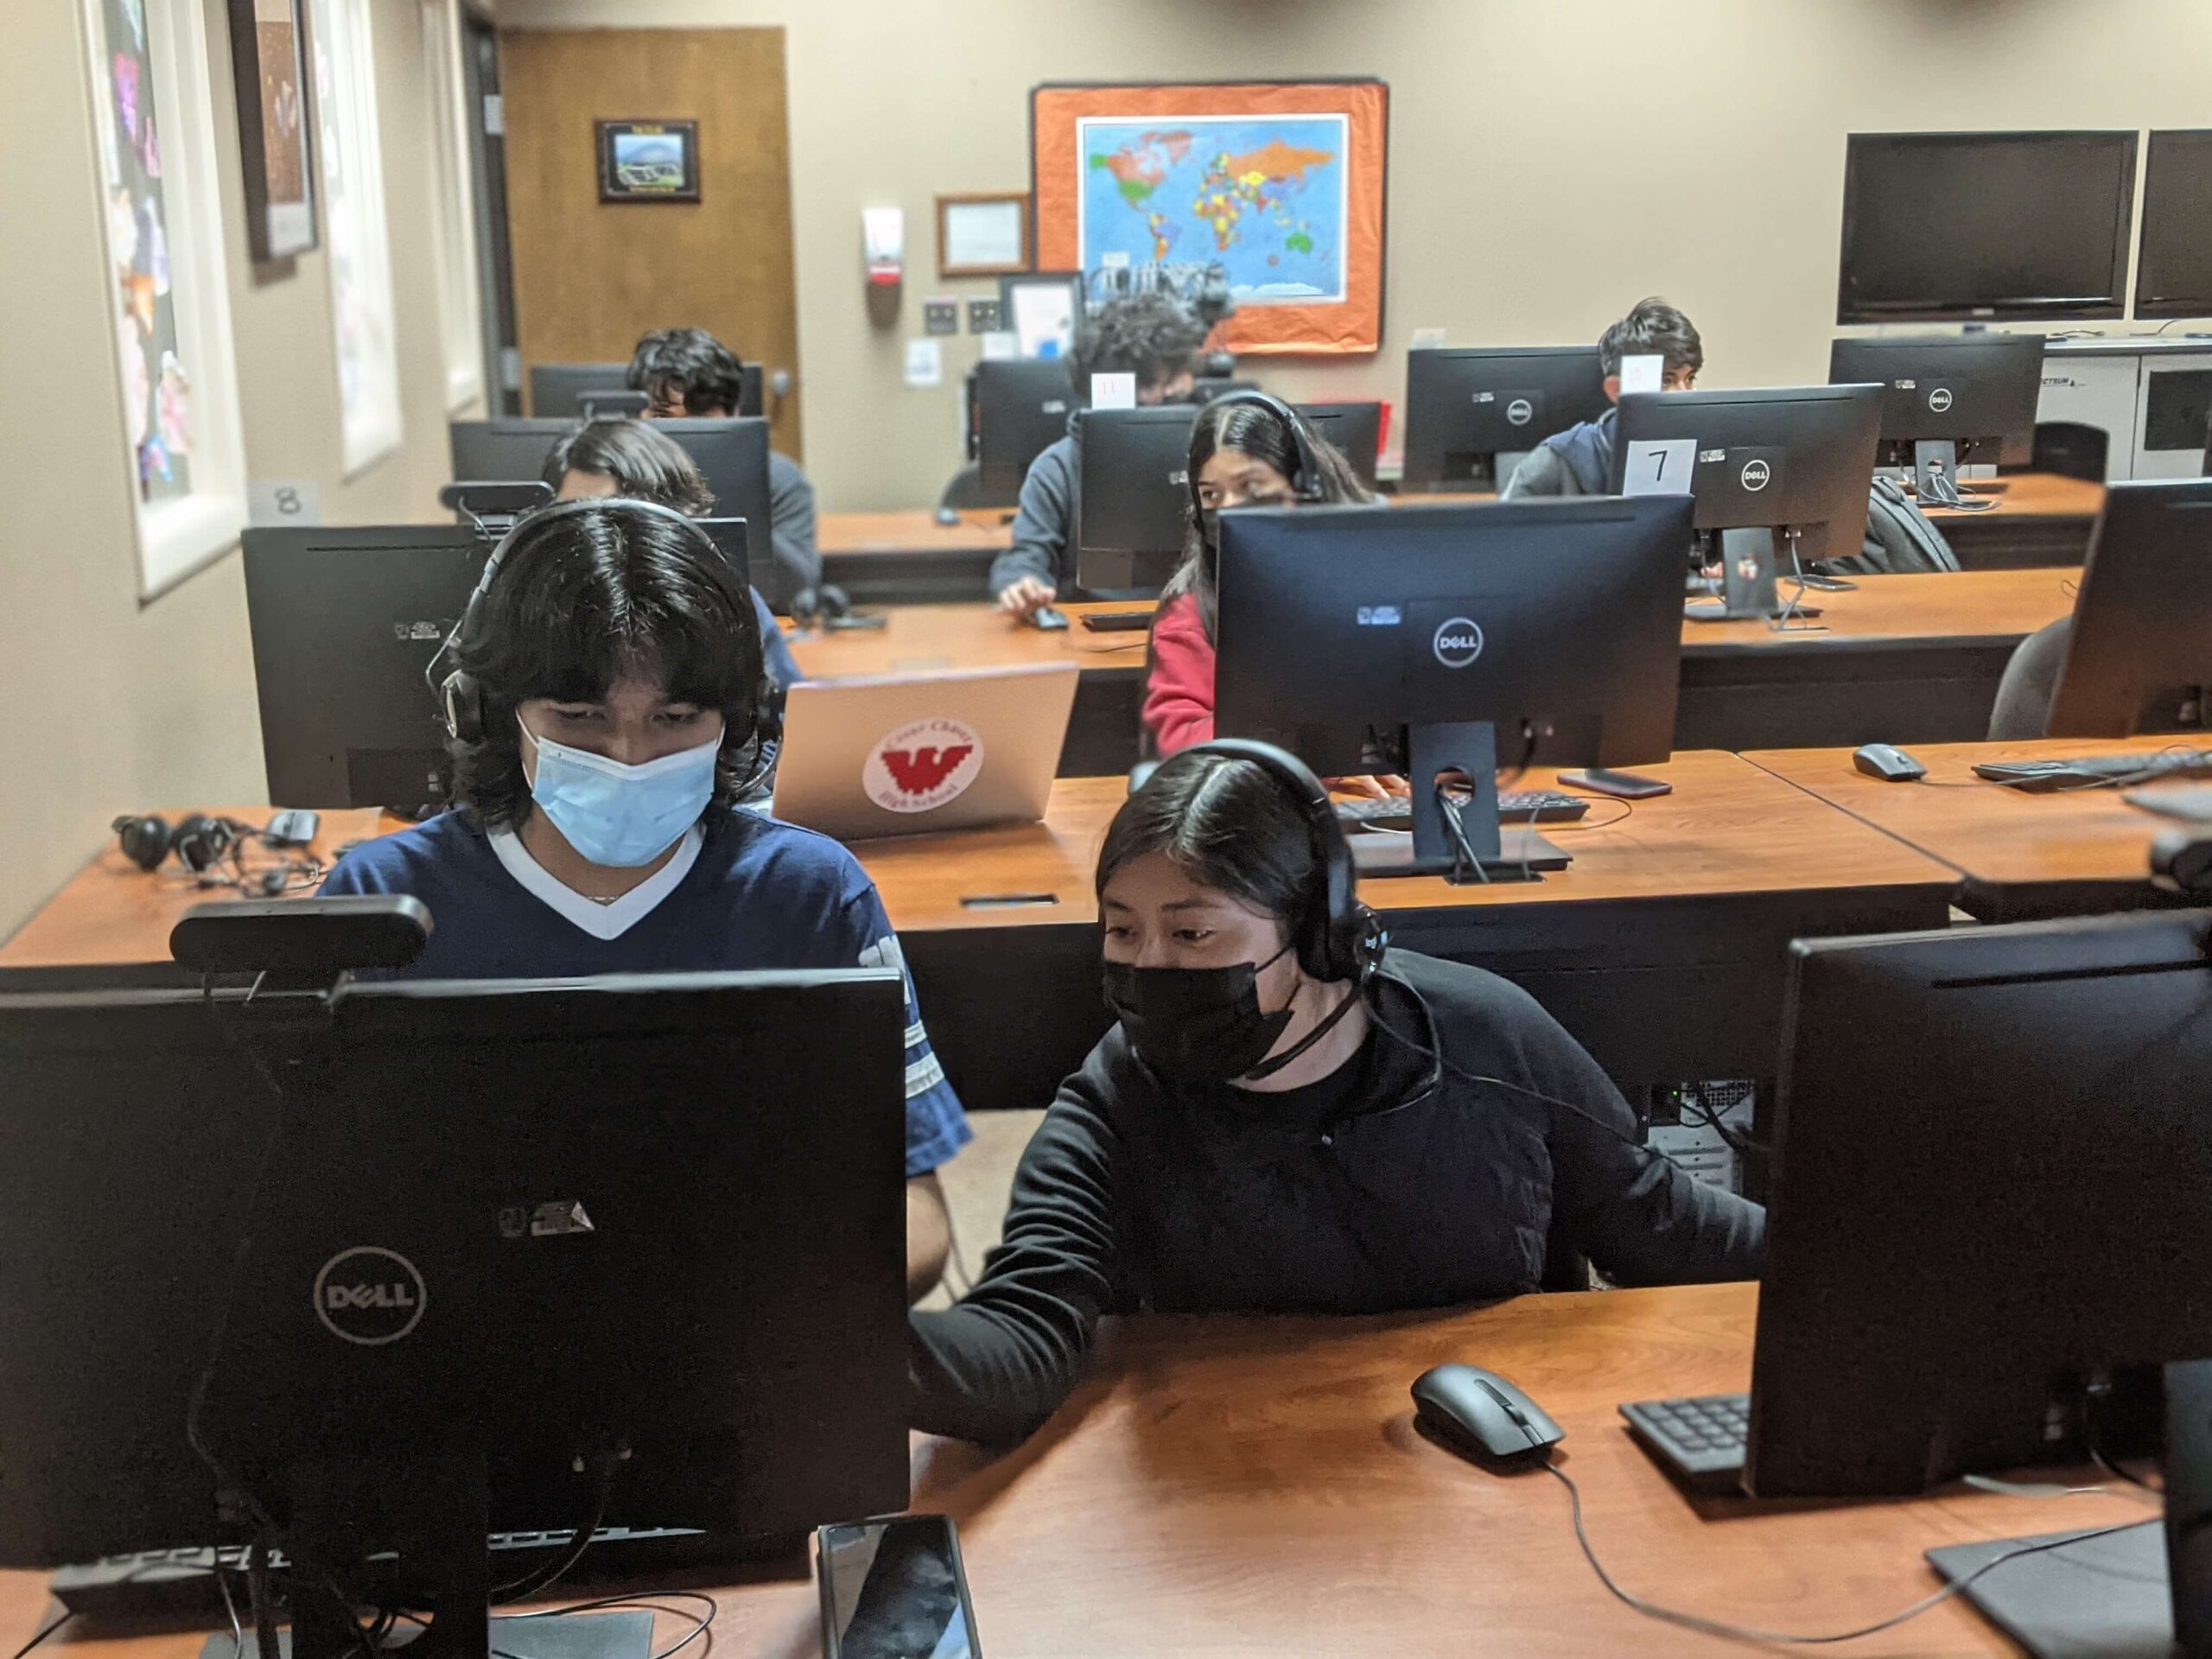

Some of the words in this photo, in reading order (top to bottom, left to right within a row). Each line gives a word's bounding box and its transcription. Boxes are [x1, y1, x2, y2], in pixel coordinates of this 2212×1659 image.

[1648, 450, 1668, 481] 7
[1745, 471, 1766, 480] DELL
[274, 487, 302, 514] 8
[1440, 635, 1477, 649] DELL
[327, 1283, 415, 1309] DELL
